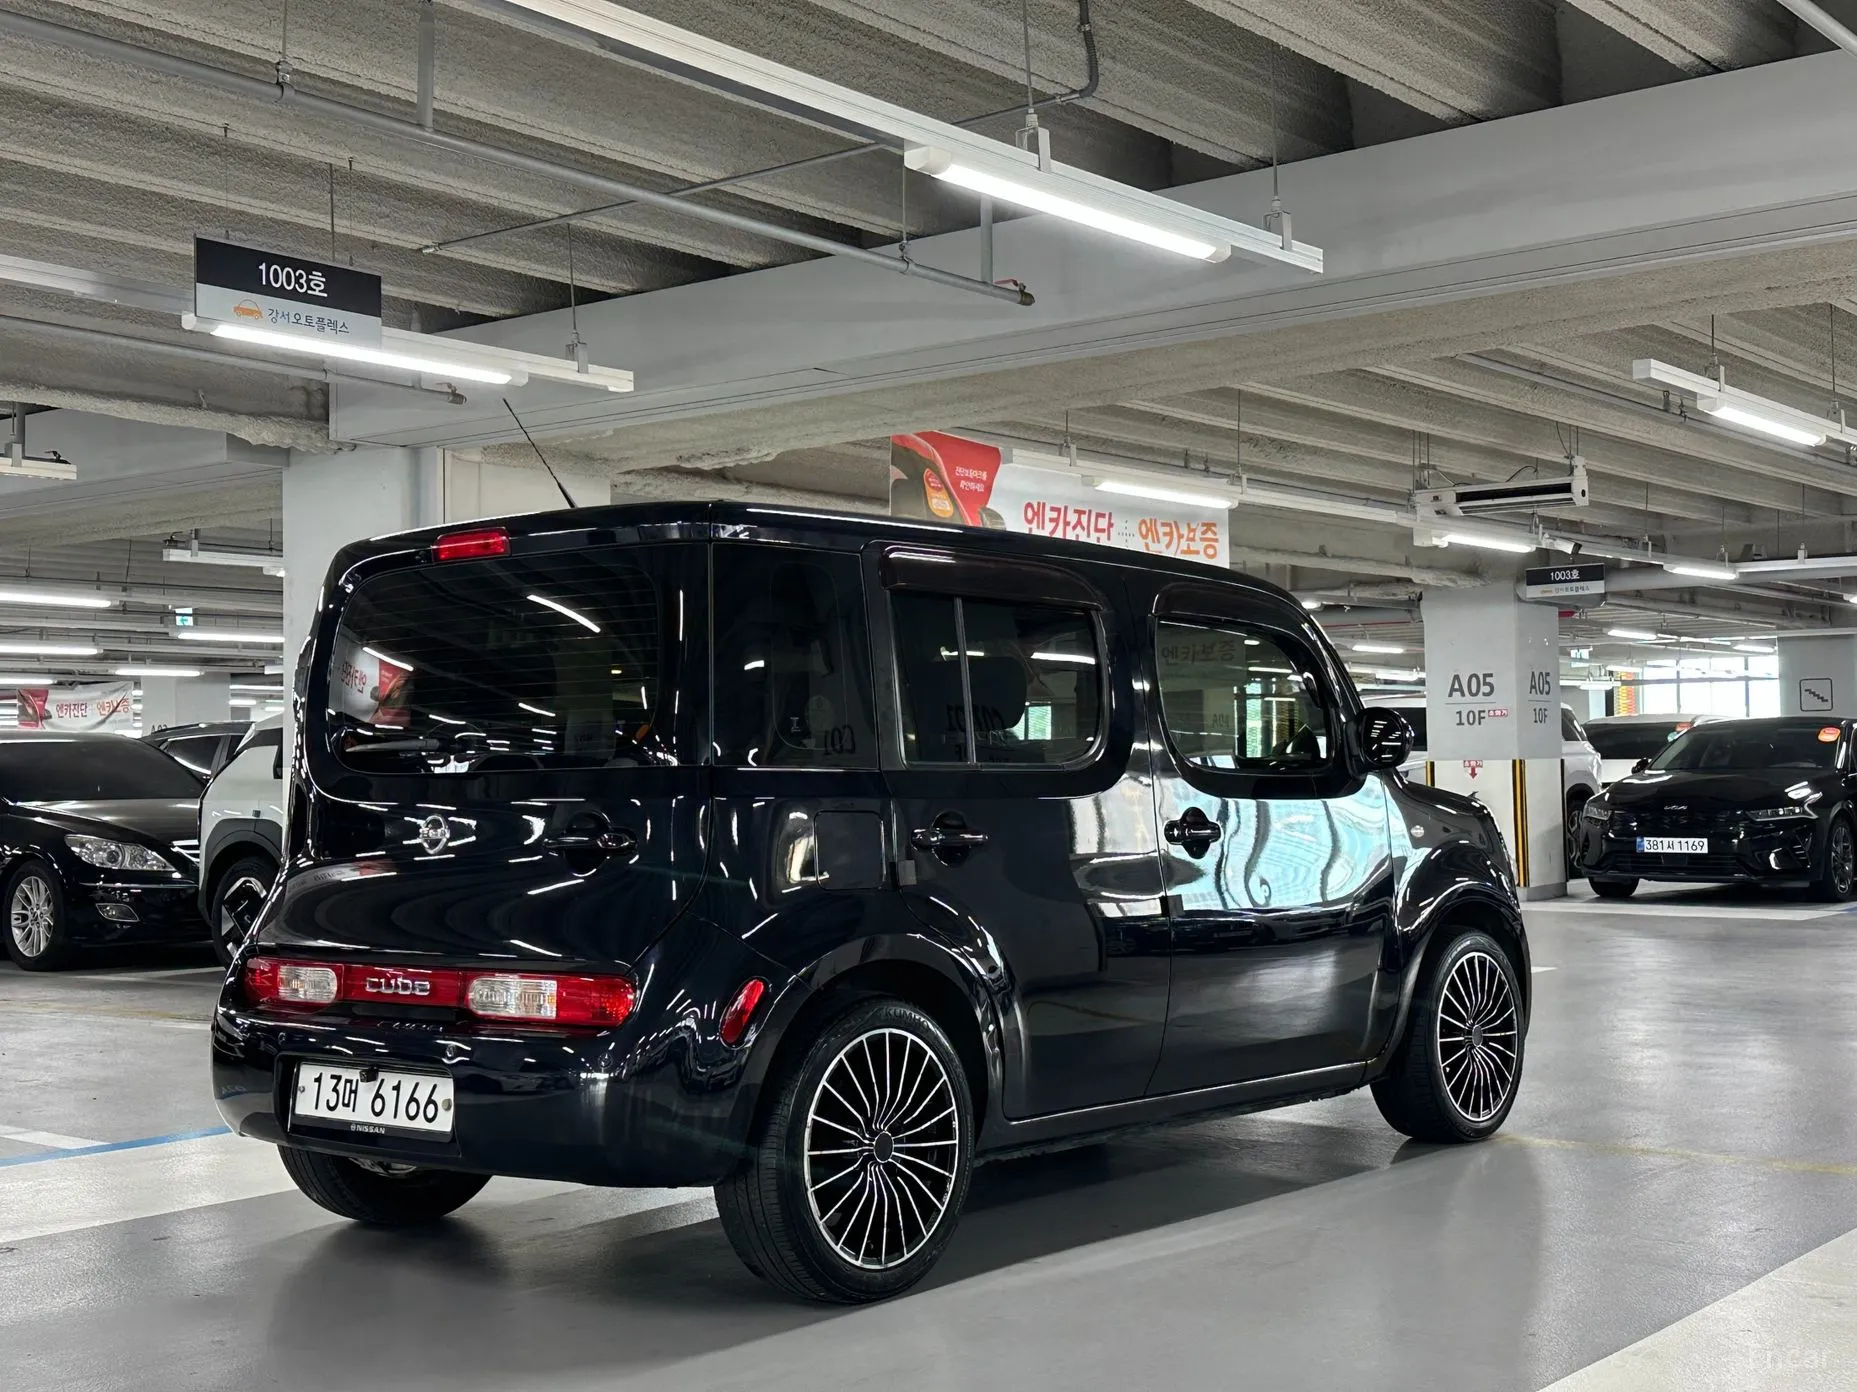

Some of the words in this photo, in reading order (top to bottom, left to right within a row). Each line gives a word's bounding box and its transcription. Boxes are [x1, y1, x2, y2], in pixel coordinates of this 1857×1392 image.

[258, 262, 328, 297] 1003호
[268, 308, 350, 335] 강서오토플렉스
[1023, 502, 1114, 542] 엔카진단
[1138, 518, 1219, 560] 엔카보증
[1550, 569, 1580, 581] 1003호
[1448, 673, 1495, 698] A05
[1529, 671, 1551, 696] A05
[56, 702, 87, 719] 엔카진단
[1455, 710, 1486, 726] 10F
[1533, 708, 1548, 724] 10F
[1645, 839, 1675, 851] 381서
[1678, 840, 1705, 851] 1169
[313, 1072, 359, 1112] 13머
[371, 1079, 438, 1123] 6166
[356, 1124, 386, 1134] NISSAN
